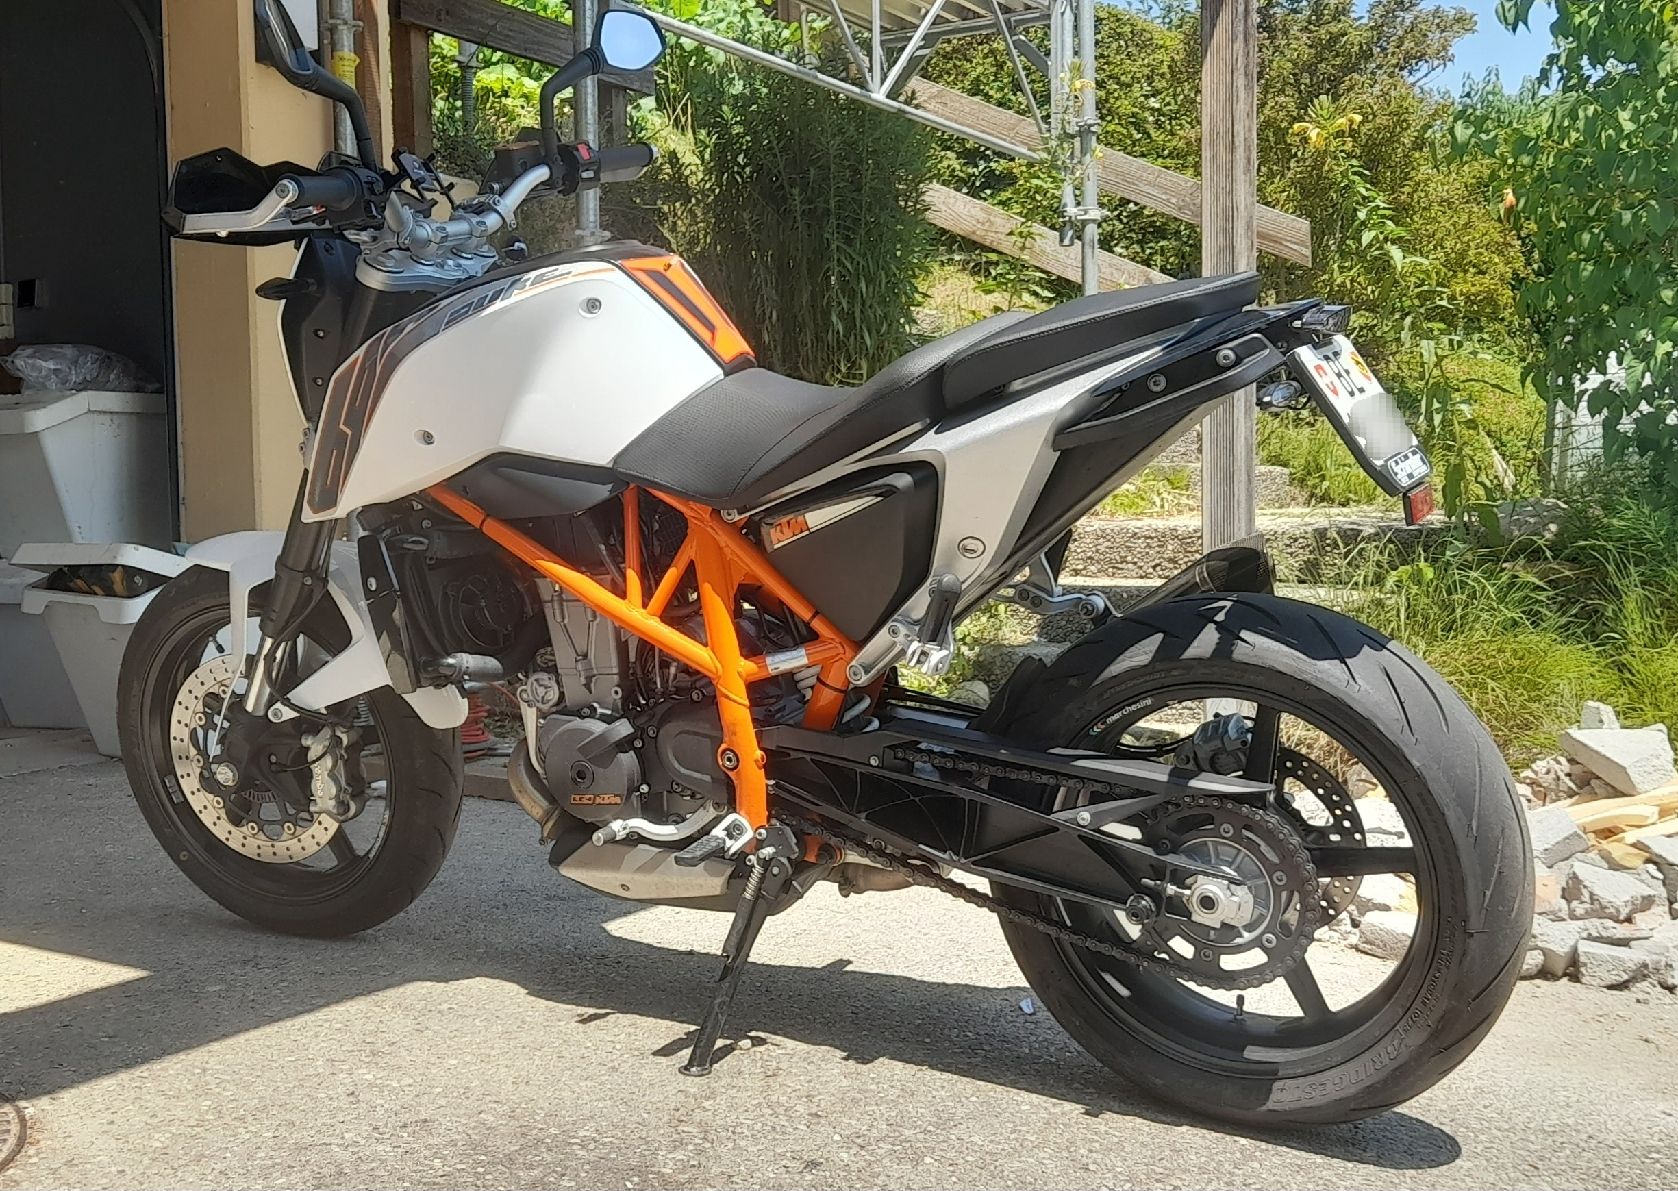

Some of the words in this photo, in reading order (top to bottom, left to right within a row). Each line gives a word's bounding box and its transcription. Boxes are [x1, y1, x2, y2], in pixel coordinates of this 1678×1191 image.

[1322, 351, 1366, 398] BE
[770, 514, 809, 545] KTM
[1106, 697, 1153, 724] marchesini
